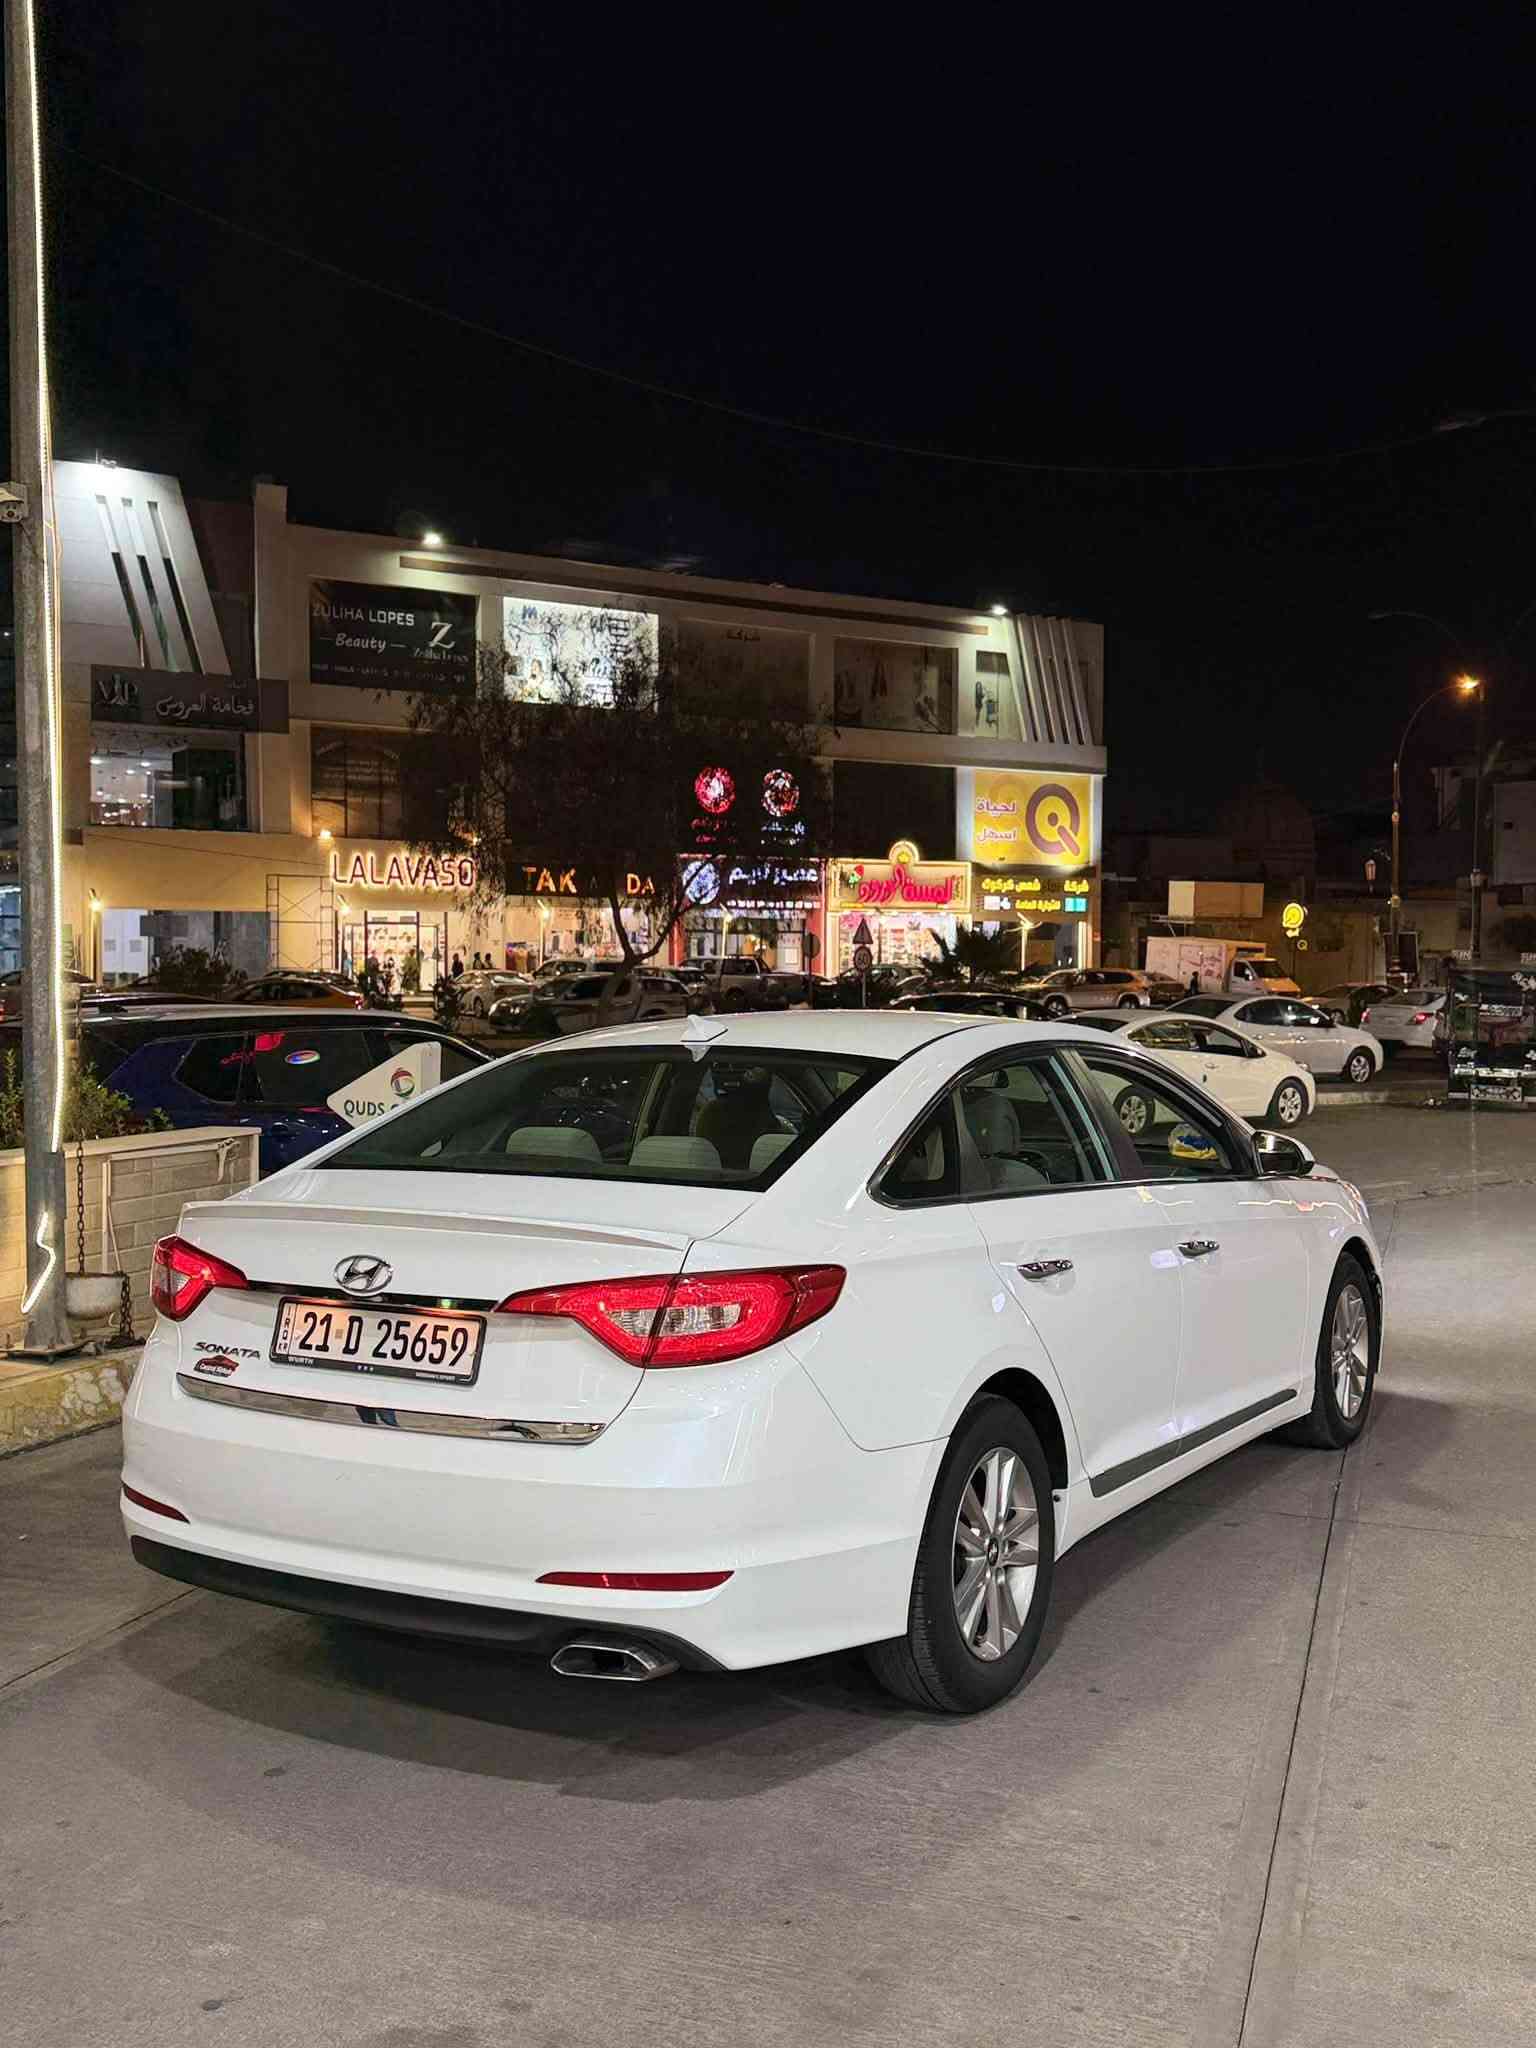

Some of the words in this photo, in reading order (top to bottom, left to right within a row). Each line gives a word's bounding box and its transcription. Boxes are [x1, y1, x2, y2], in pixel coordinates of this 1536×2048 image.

[369, 610, 415, 626] LOPES
[335, 633, 387, 653] Beauty
[155, 692, 207, 720] العروس
[976, 799, 1017, 816] لحياة
[332, 852, 475, 887] LALAVASO
[343, 1099, 385, 1118] QUDS
[299, 1311, 333, 1353] 21
[342, 1315, 363, 1355] D
[372, 1319, 470, 1367] 25659
[195, 1341, 261, 1361] SONATA
